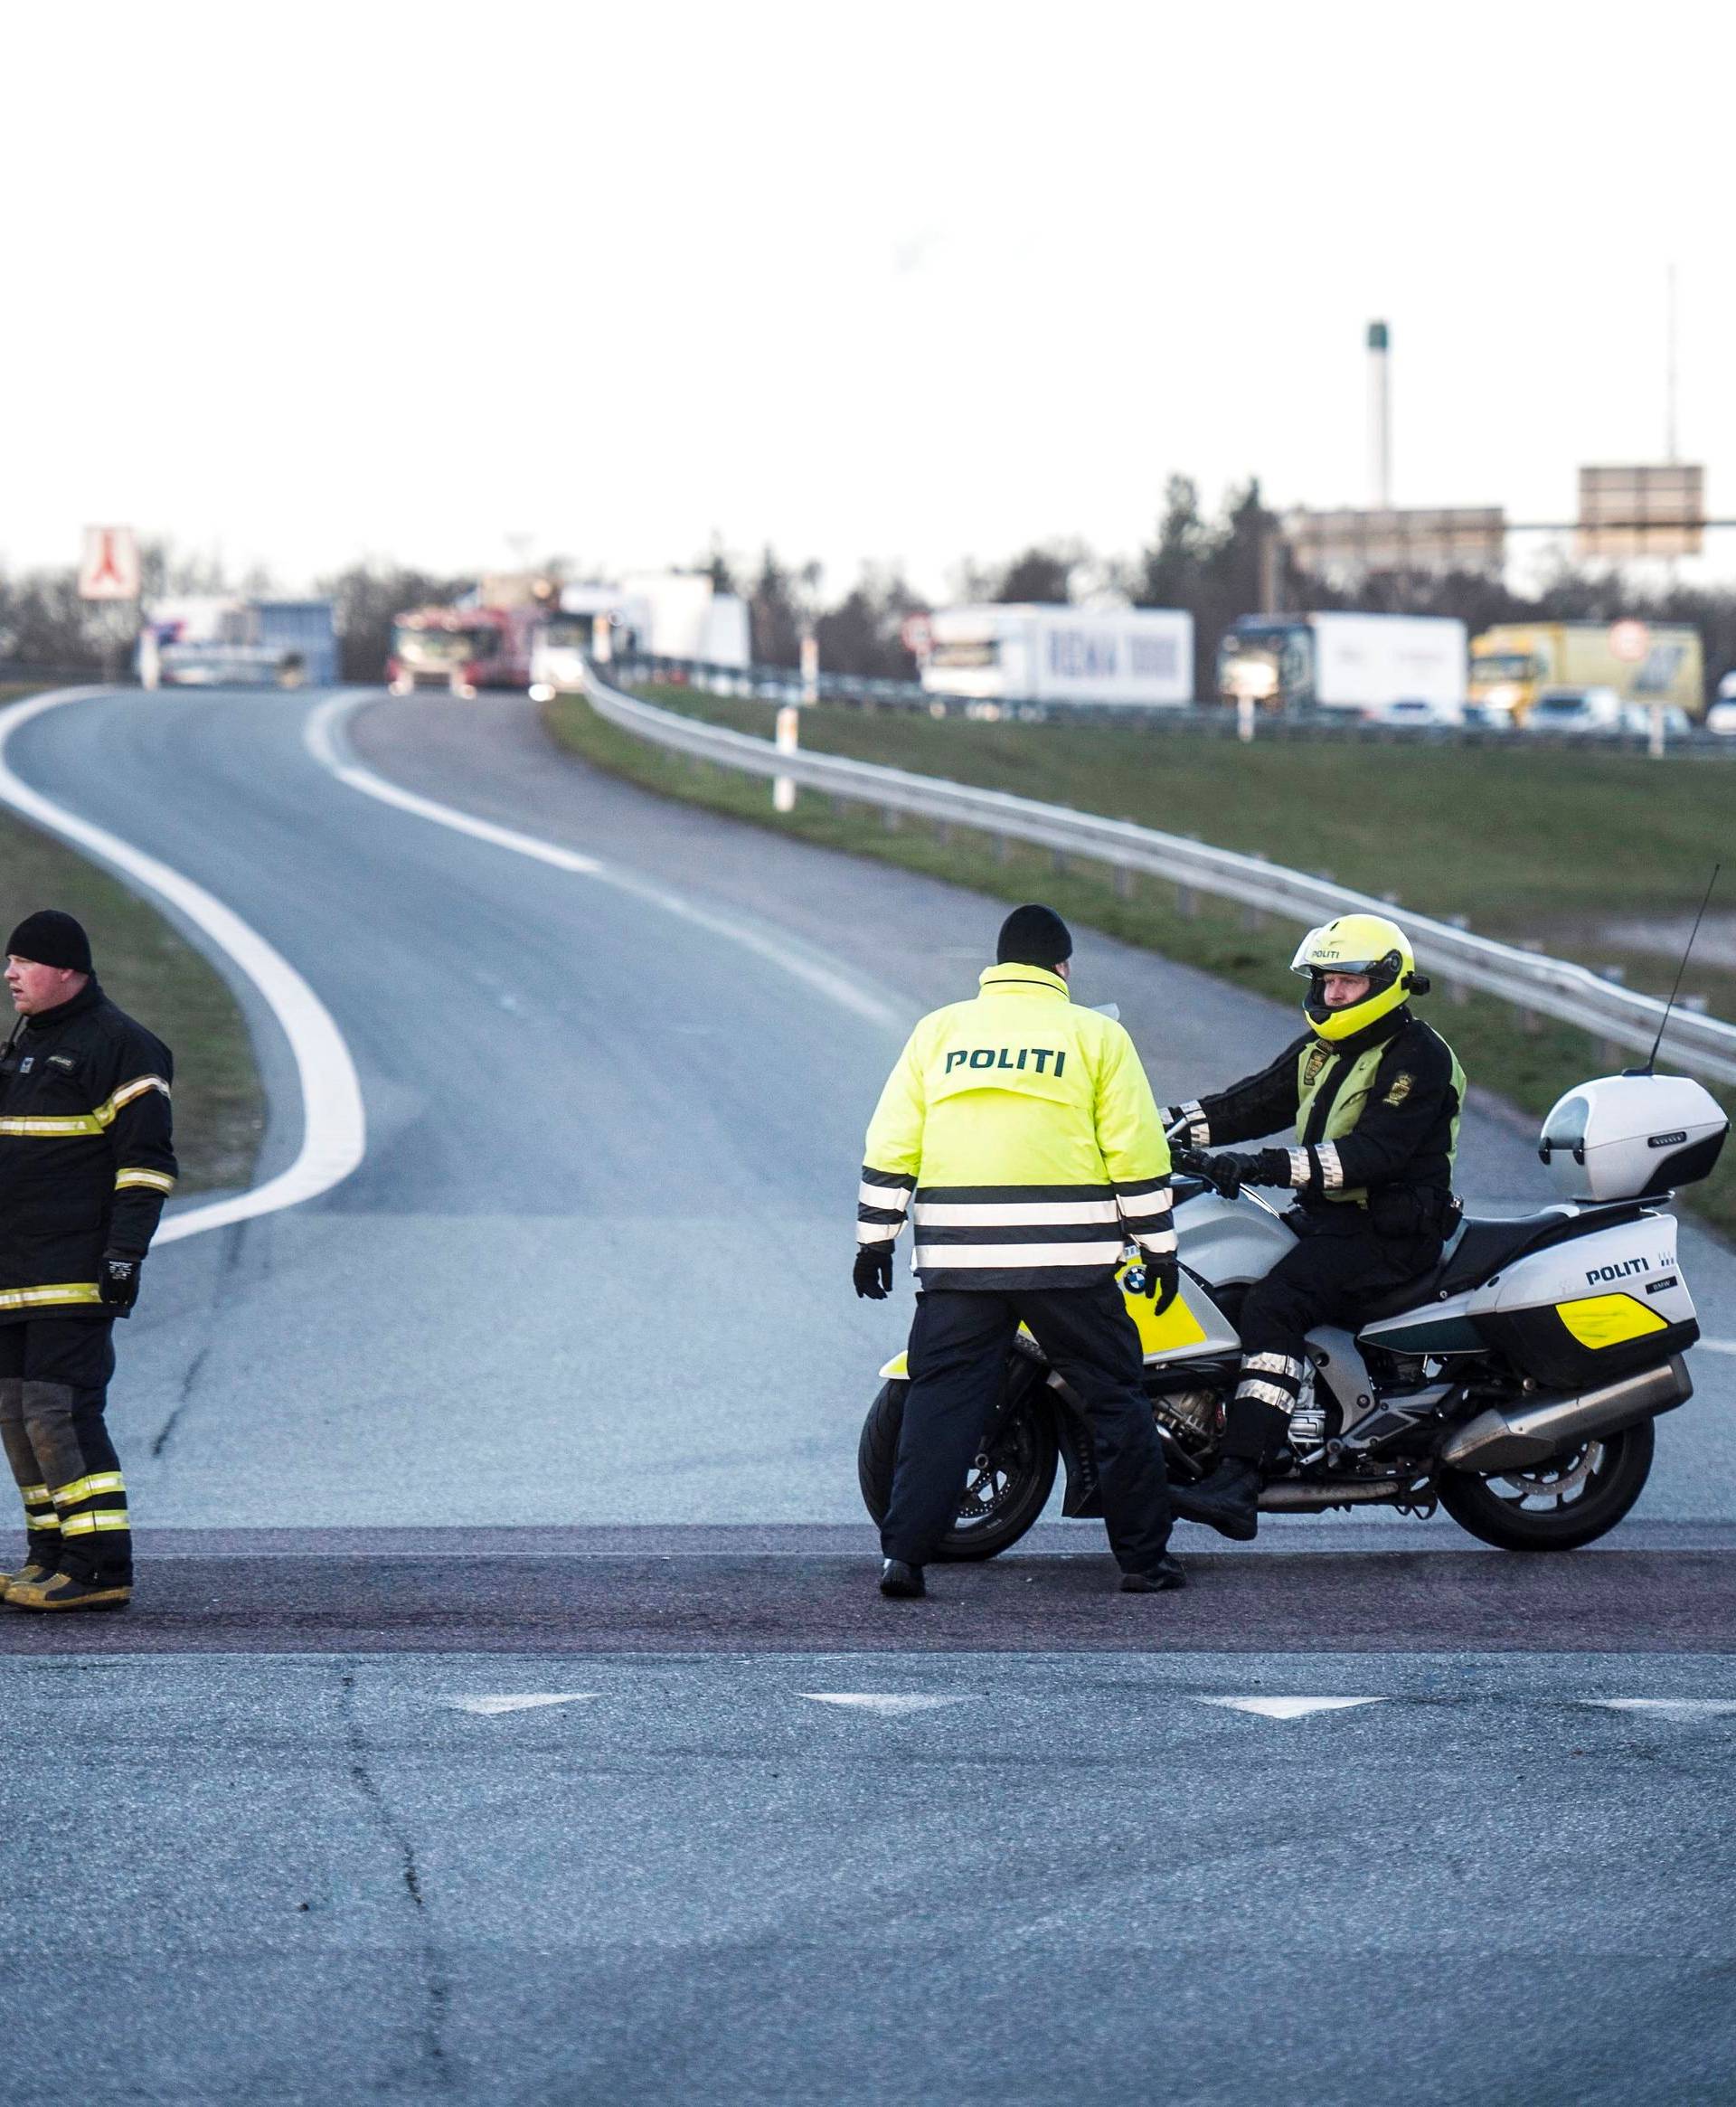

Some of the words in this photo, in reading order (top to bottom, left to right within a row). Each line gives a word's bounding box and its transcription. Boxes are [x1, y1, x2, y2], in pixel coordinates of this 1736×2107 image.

[1312, 950, 1340, 959] POLITI
[946, 1048, 1066, 1078] POLITI
[1586, 1257, 1649, 1285] POLITI
